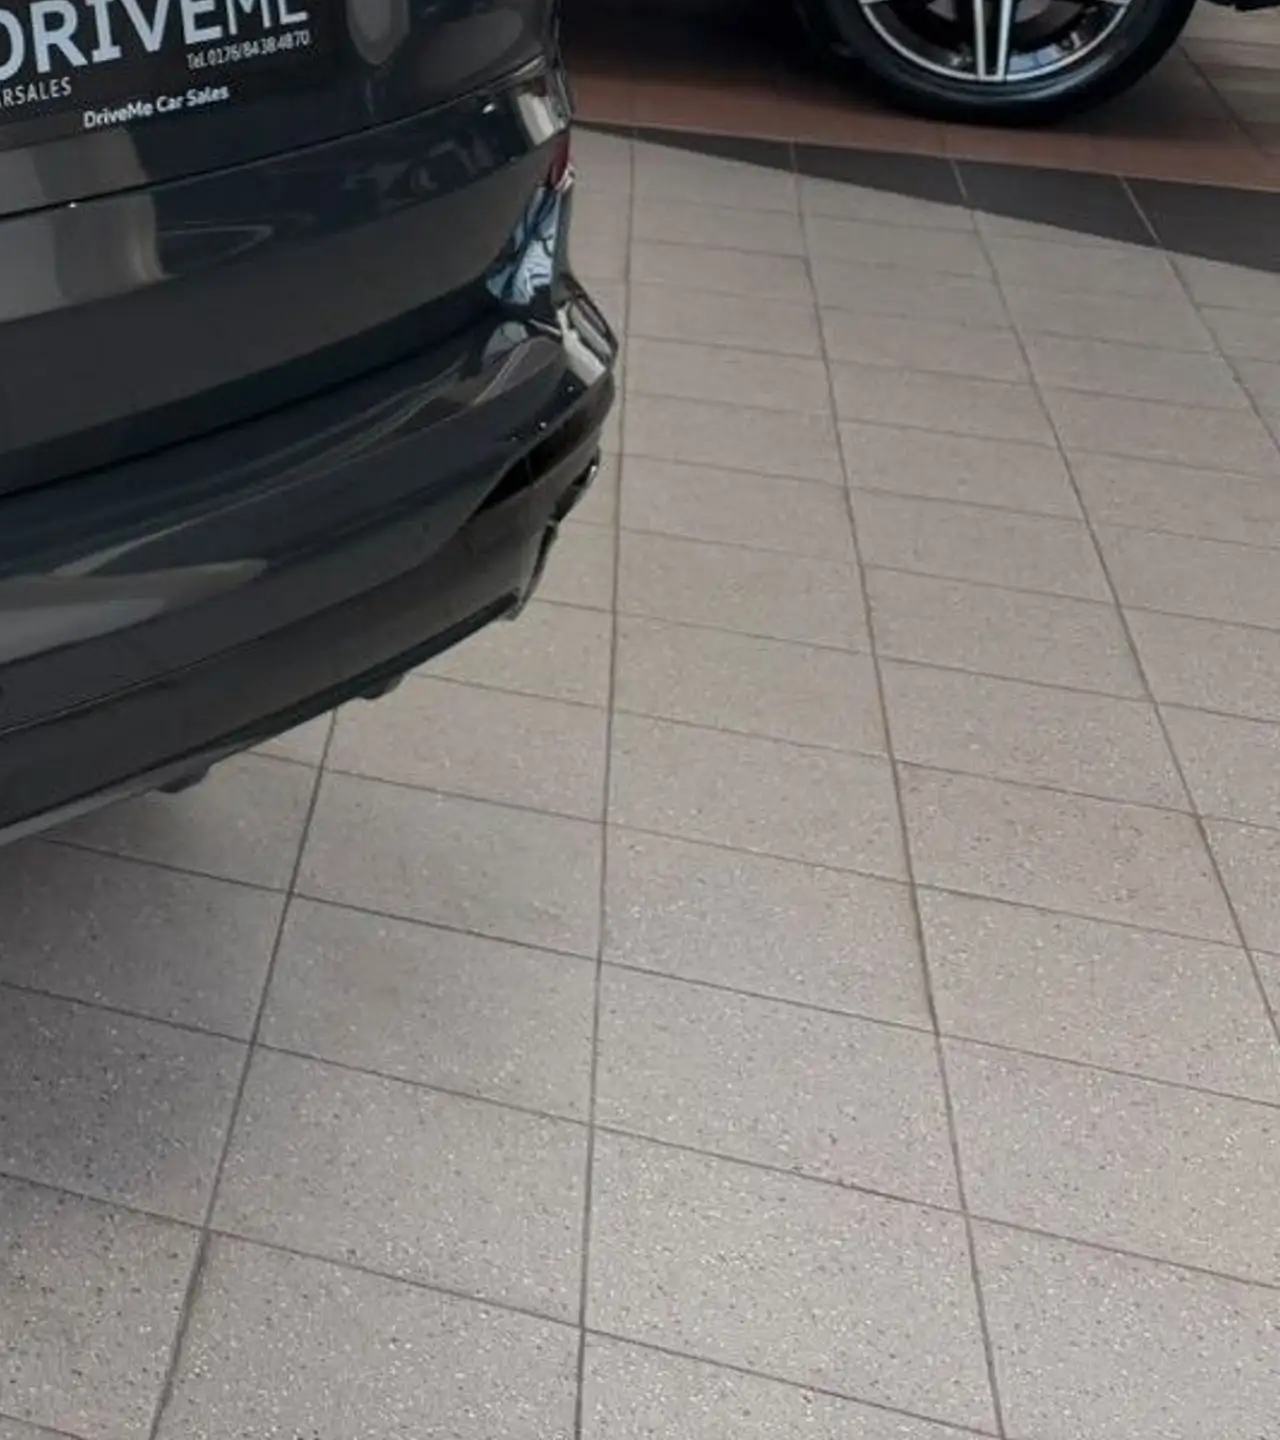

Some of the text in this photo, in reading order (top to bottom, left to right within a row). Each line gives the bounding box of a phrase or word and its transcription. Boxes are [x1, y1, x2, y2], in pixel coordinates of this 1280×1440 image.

[83, 86, 229, 129] DriveMe Car Sales
